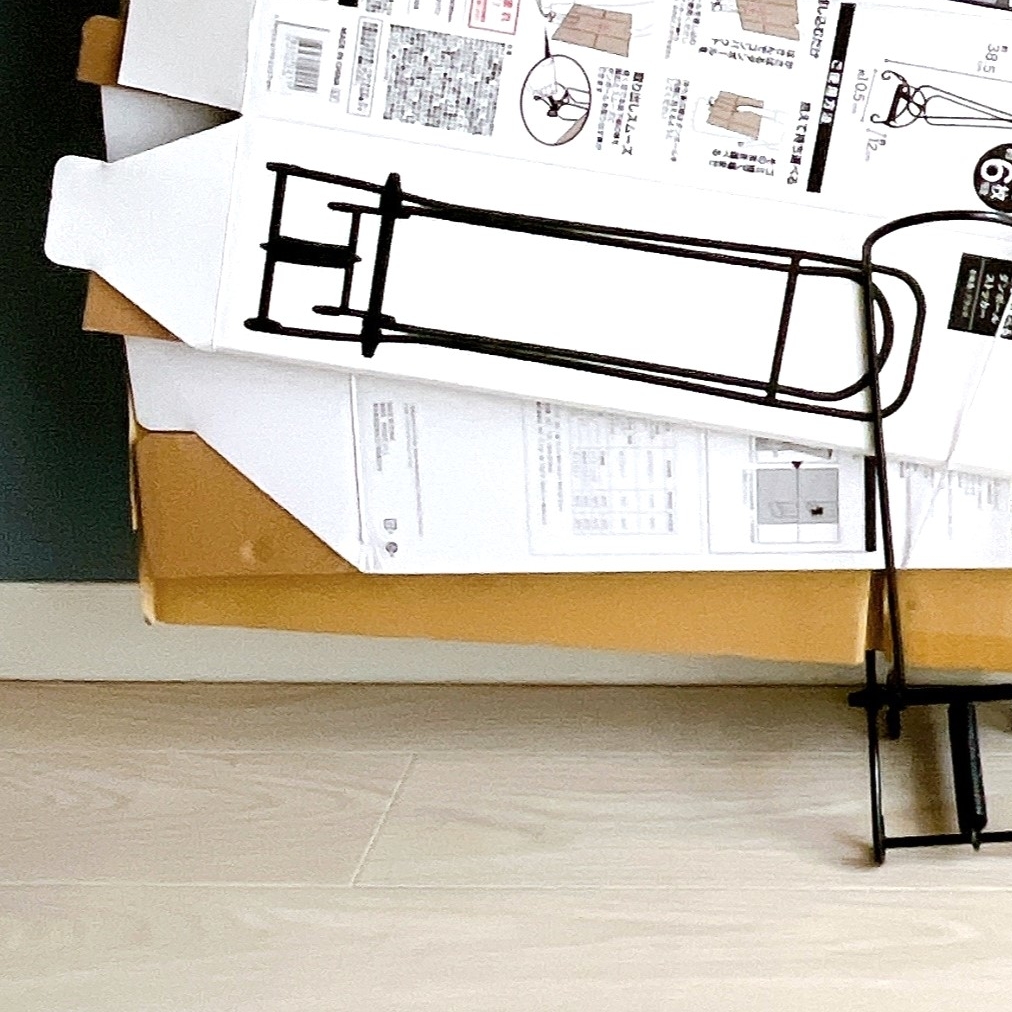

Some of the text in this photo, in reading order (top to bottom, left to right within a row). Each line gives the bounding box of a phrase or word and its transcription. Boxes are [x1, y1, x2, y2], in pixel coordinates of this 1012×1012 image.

[621, 71, 644, 156] 取り出しスムーズ
